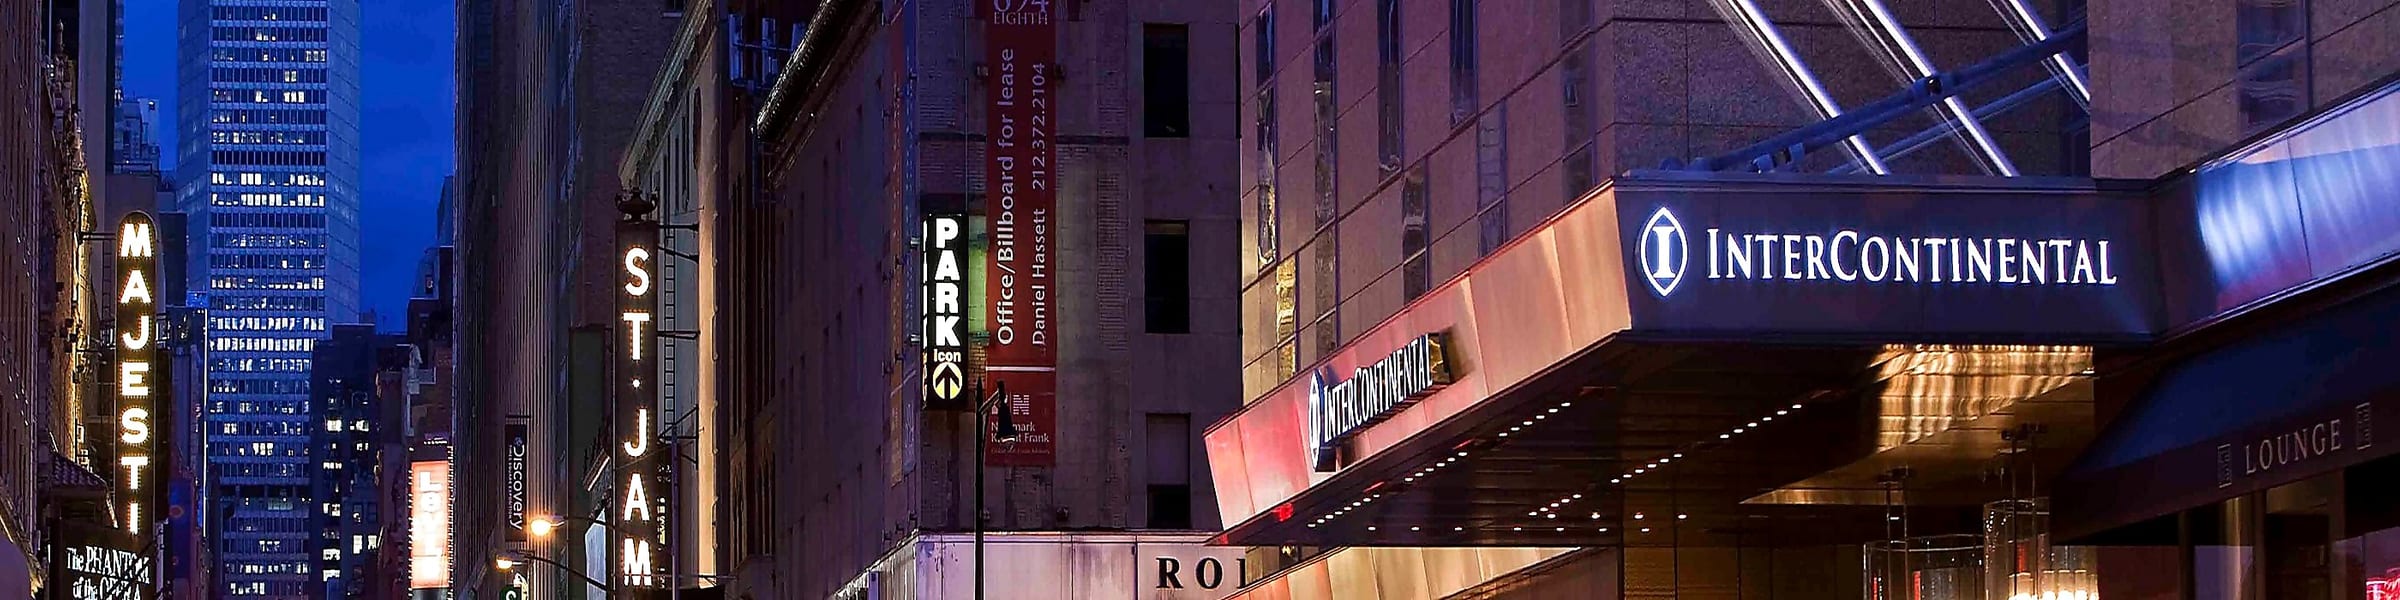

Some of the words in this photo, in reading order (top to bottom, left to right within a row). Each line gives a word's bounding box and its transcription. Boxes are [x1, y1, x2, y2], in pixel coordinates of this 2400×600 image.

[993, 11, 1048, 25] EIGHTH
[997, 48, 1014, 106] lease
[998, 114, 1014, 147] for
[1032, 63, 1046, 191] 212.372.2104
[997, 156, 1015, 345] Office/Billboard
[1032, 208, 1046, 278] Hassett
[934, 218, 961, 347] PARK
[1032, 285, 1046, 345] Daniel
[991, 421, 1036, 432] Nmark
[1024, 432, 1050, 443] Frank
[2245, 419, 2342, 475] LOUNGE
[623, 409, 652, 587] JAM
[66, 547, 84, 571] The
